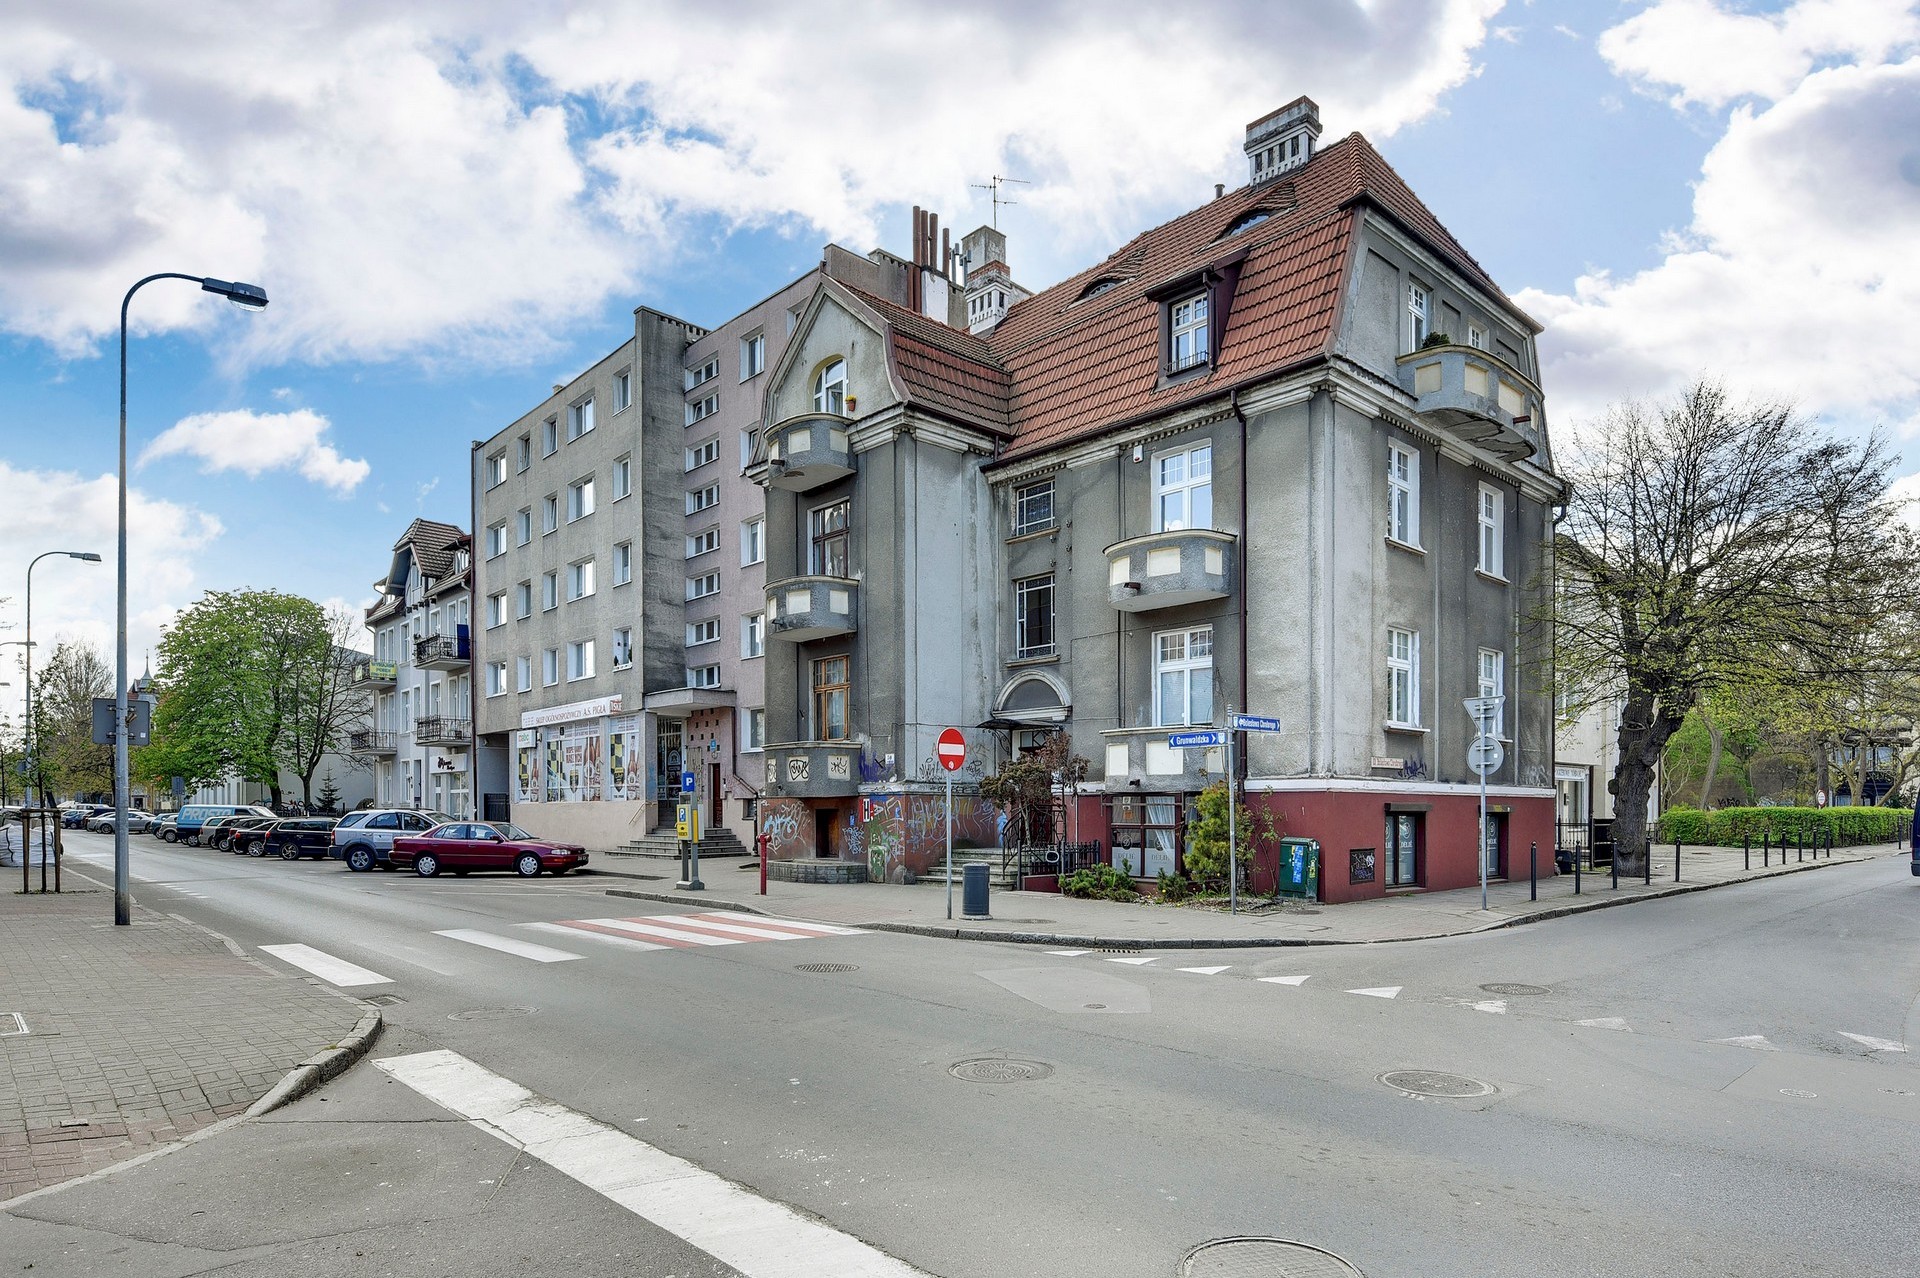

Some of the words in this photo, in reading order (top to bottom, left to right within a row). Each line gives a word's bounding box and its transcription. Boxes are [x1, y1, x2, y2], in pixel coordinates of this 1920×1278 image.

[1176, 734, 1209, 745] Grunwaldzka
[686, 777, 693, 786] P
[680, 808, 685, 819] P
